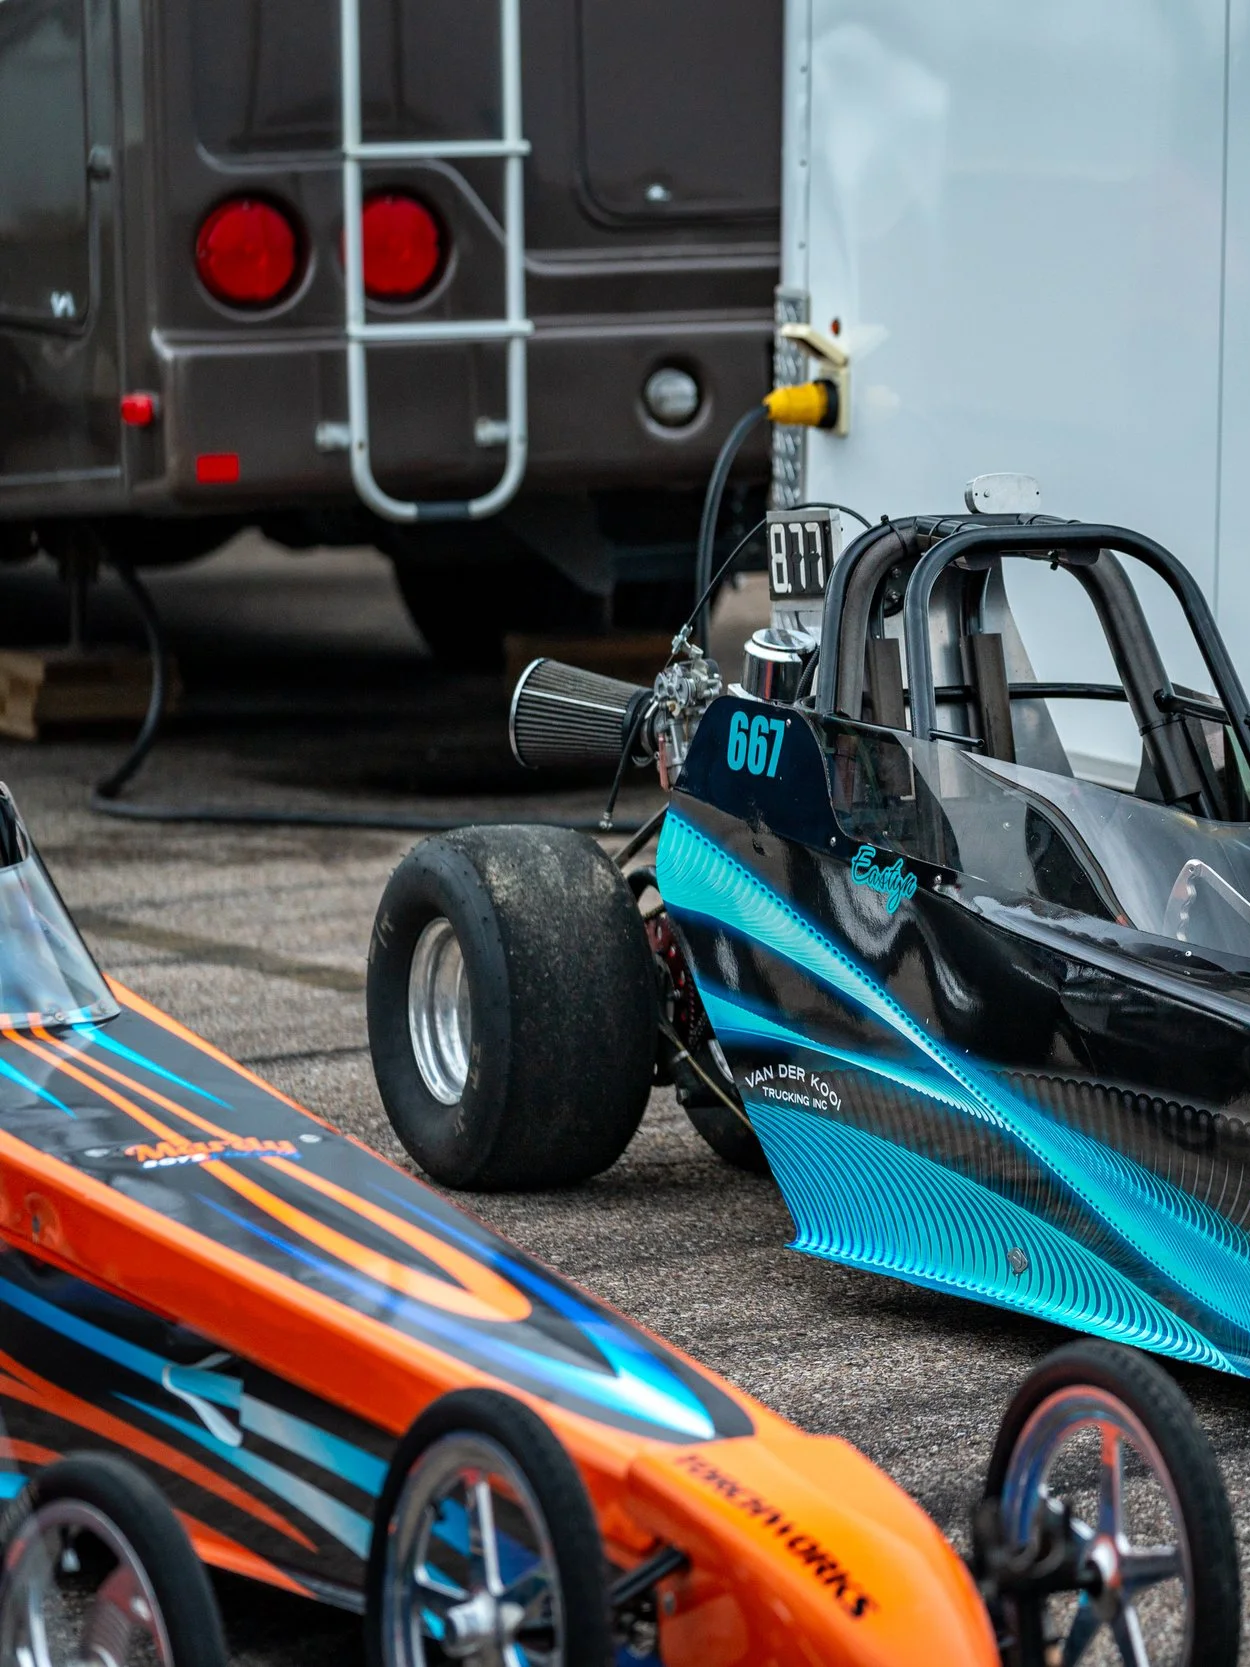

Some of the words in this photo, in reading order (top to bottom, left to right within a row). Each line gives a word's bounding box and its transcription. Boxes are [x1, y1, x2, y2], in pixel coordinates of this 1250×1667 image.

[727, 710, 785, 778] 667
[745, 1065, 774, 1088] VAN
[778, 1063, 806, 1082] DER
[810, 1073, 842, 1111] KOOI
[762, 1086, 810, 1107] TRUCKING
[812, 1097, 828, 1110] INC
